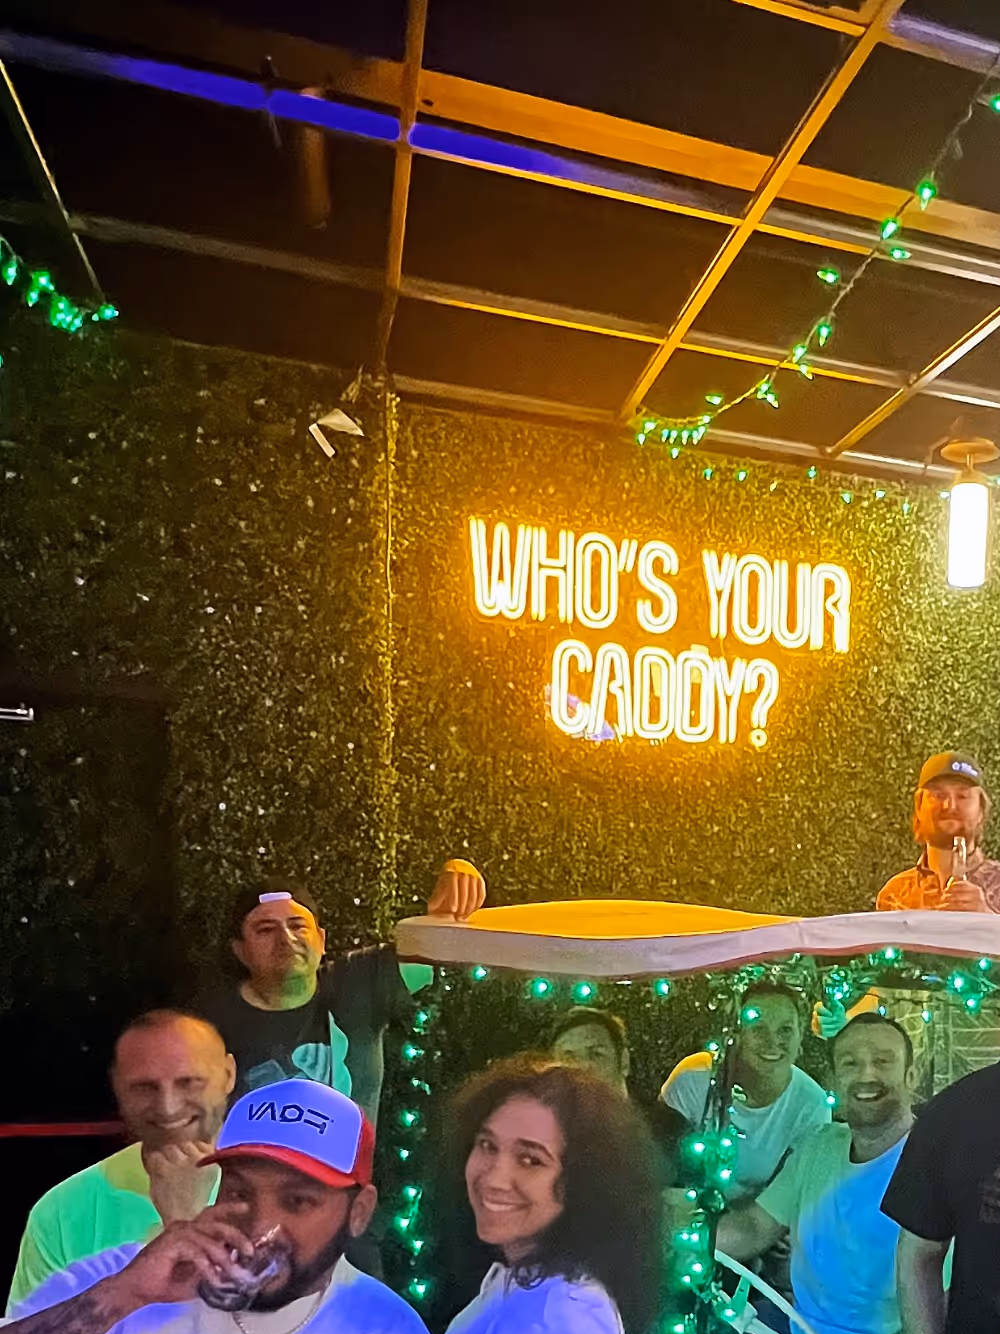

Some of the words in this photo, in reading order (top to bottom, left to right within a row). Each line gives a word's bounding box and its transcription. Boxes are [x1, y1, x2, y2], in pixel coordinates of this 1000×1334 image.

[469, 516, 679, 634] WHO'S
[703, 549, 851, 653] YOUR
[550, 638, 780, 747] CADDY?
